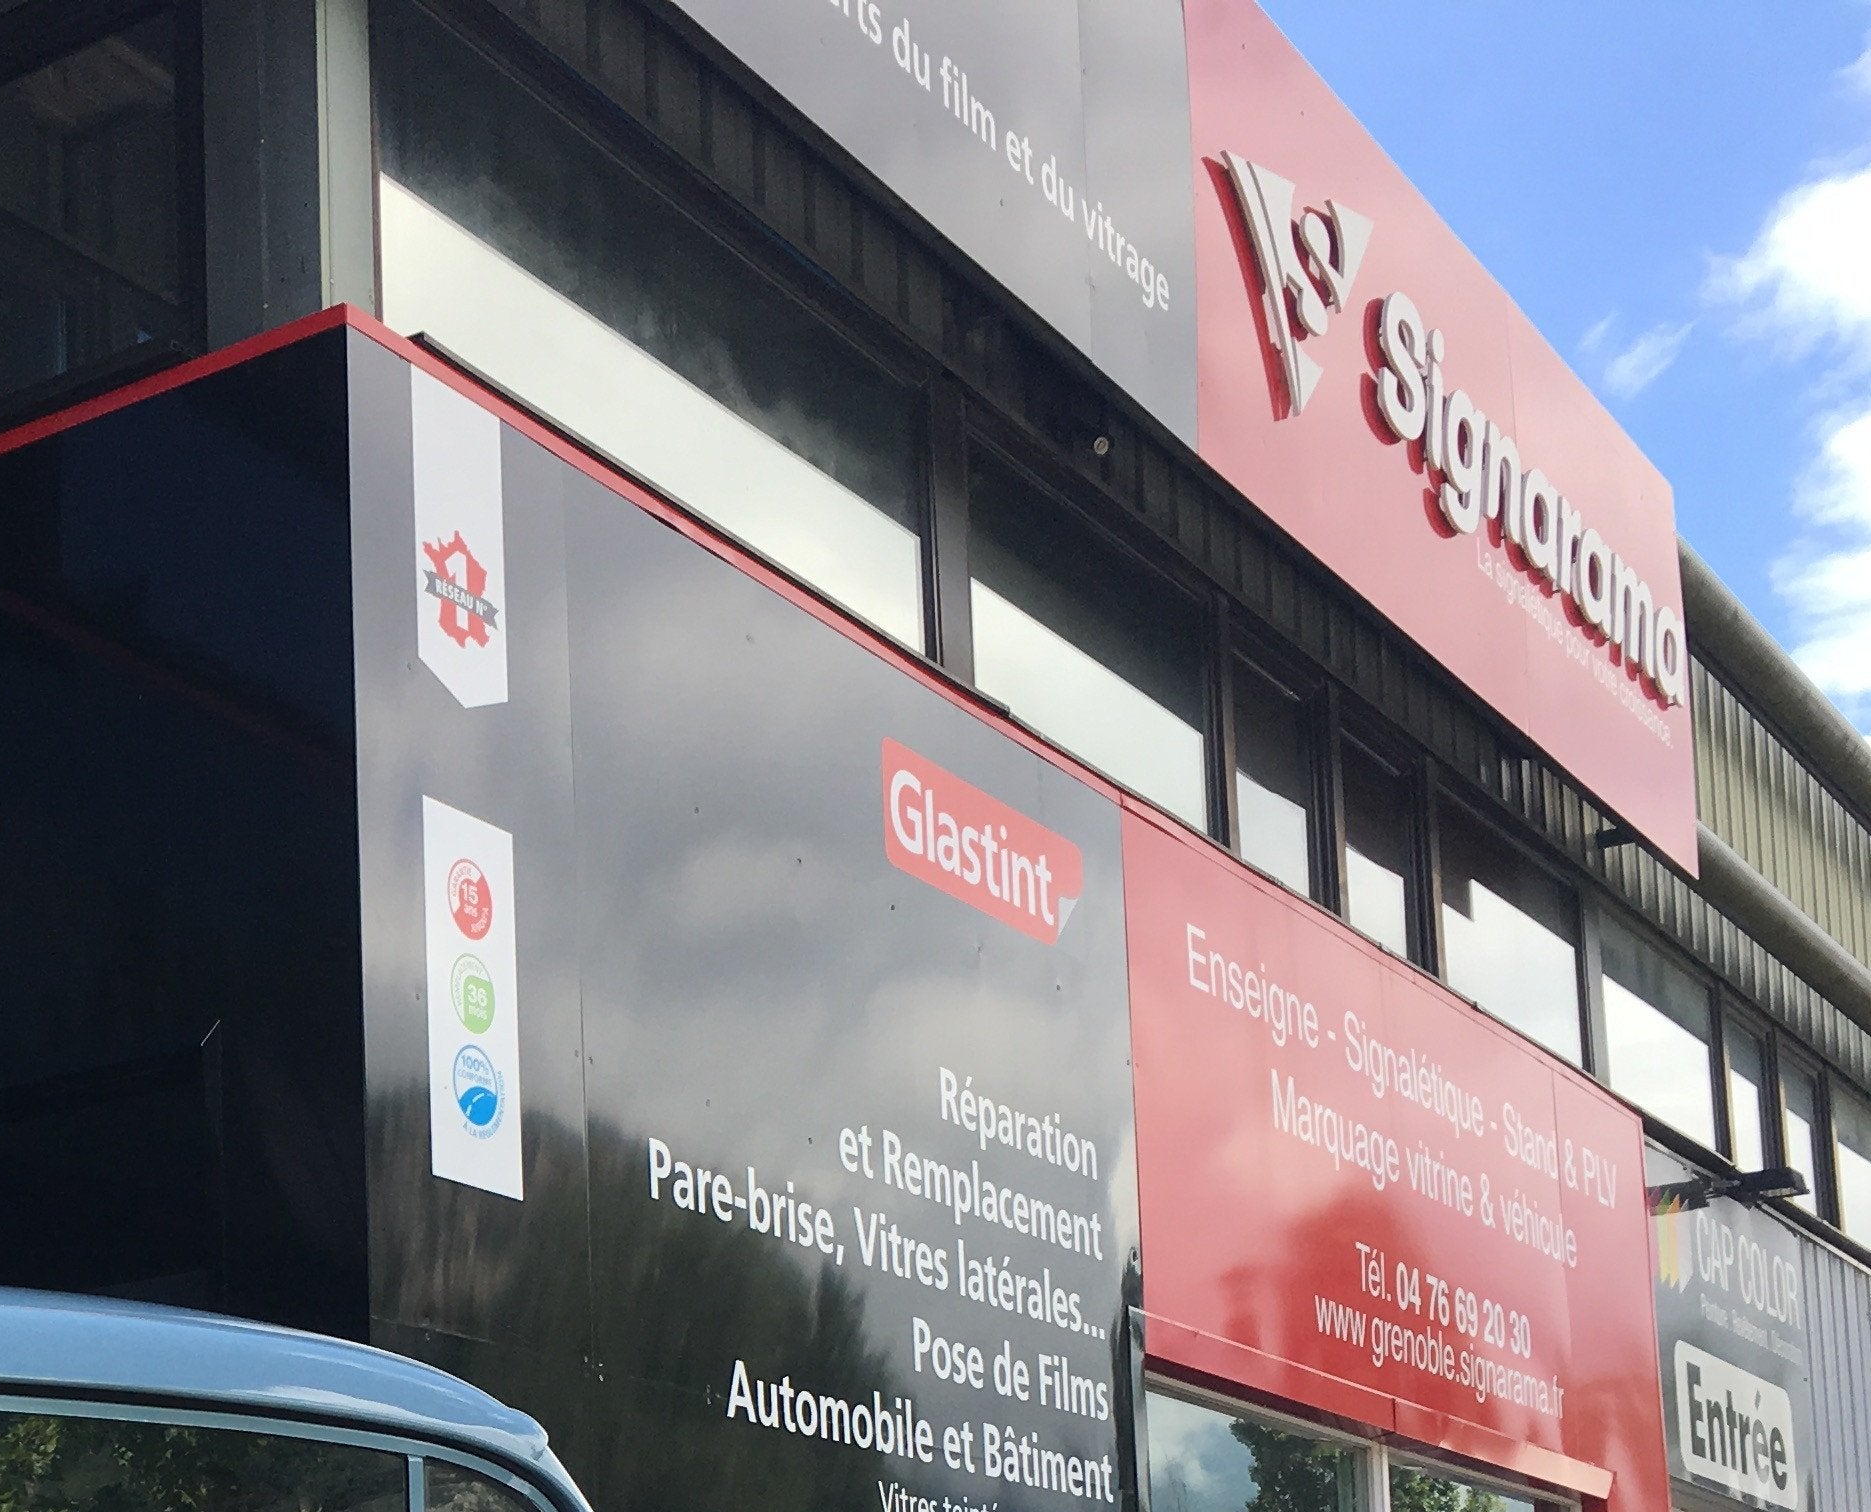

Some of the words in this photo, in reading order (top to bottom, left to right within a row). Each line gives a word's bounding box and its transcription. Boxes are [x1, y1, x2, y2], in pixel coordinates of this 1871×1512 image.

[830, 0, 882, 45] ts
[892, 18, 931, 92] du
[940, 56, 997, 151] film
[1006, 130, 1034, 185] et
[1042, 156, 1075, 220] du
[1082, 199, 1170, 311] vitrage
[1377, 291, 1686, 708] Signarama
[462, 882, 479, 905] 15
[890, 769, 1055, 926] Glastint
[939, 1066, 1099, 1182] Réparation
[1186, 923, 1319, 1048] Enseigne
[1343, 1010, 1484, 1139] Signalétique
[1503, 1102, 1560, 1181] Stand
[1564, 1139, 1579, 1192] &
[1582, 1147, 1618, 1210] PLV
[839, 1125, 874, 1180] et
[882, 1129, 1104, 1261] Remplacement
[1270, 1068, 1400, 1192] Marquage
[1406, 1145, 1474, 1218] vitrine
[1479, 1172, 1496, 1229] &
[1499, 1189, 1578, 1268] véhicule
[648, 1137, 845, 1266] Pare-brise,
[853, 1207, 949, 1292] Vitres
[957, 1239, 1107, 1341] latérales...
[1355, 1241, 1392, 1302] Tél.
[1396, 1261, 1421, 1316] 04
[1426, 1274, 1450, 1327] 76
[1455, 1287, 1478, 1339] 69
[1483, 1300, 1506, 1349] 20
[1510, 1309, 1532, 1360] 30
[1695, 1210, 1735, 1293] CAP
[1738, 1234, 1801, 1330] COLOR
[727, 1360, 934, 1463] Automobile
[942, 1421, 976, 1474] et
[983, 1422, 1115, 1504] Bâtiment
[912, 1316, 984, 1390] Pose
[993, 1339, 1030, 1402] de
[1038, 1353, 1110, 1422] Films
[1686, 1360, 1789, 1491] Entrée
